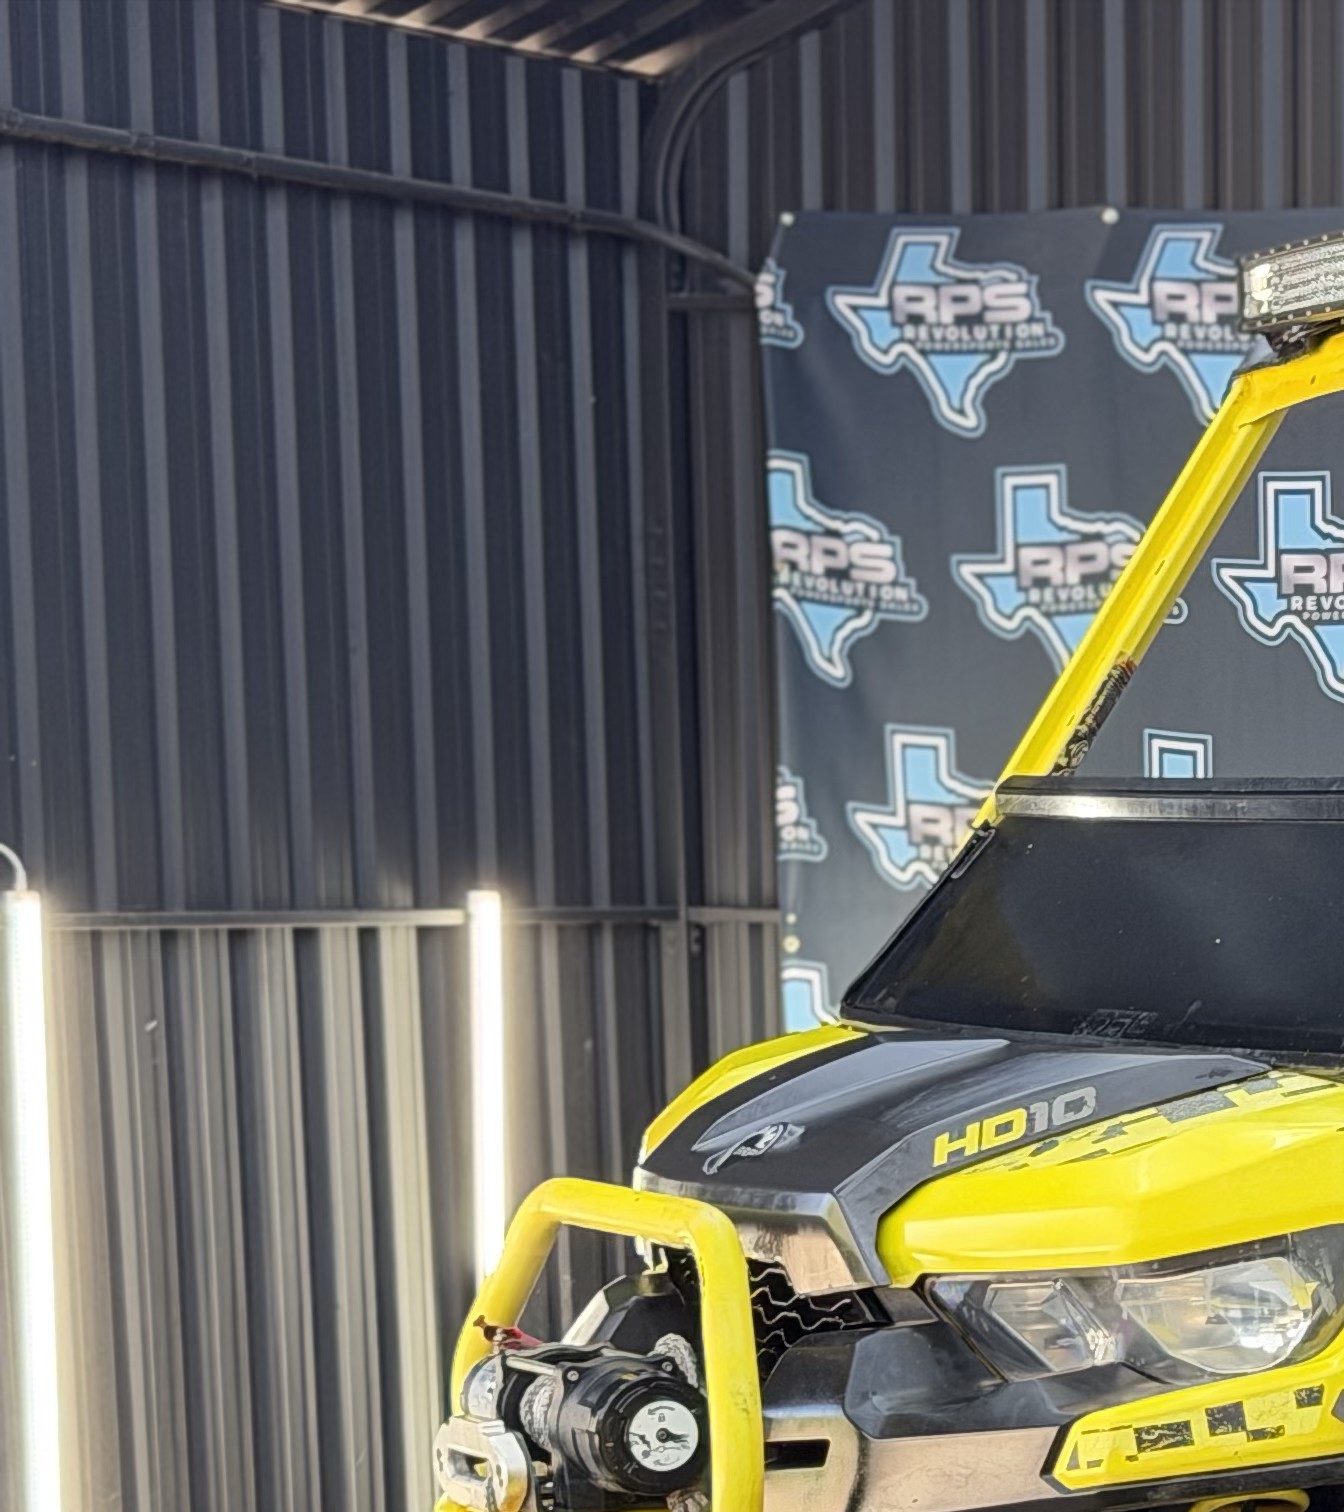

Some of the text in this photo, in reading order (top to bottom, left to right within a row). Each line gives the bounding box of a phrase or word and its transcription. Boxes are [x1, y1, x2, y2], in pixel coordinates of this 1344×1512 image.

[892, 282, 1032, 325] RPS
[1152, 281, 1238, 324] RP
[903, 322, 1045, 340] REVOLUTION
[771, 529, 897, 583] RPS
[932, 1086, 1097, 1167] HD10
